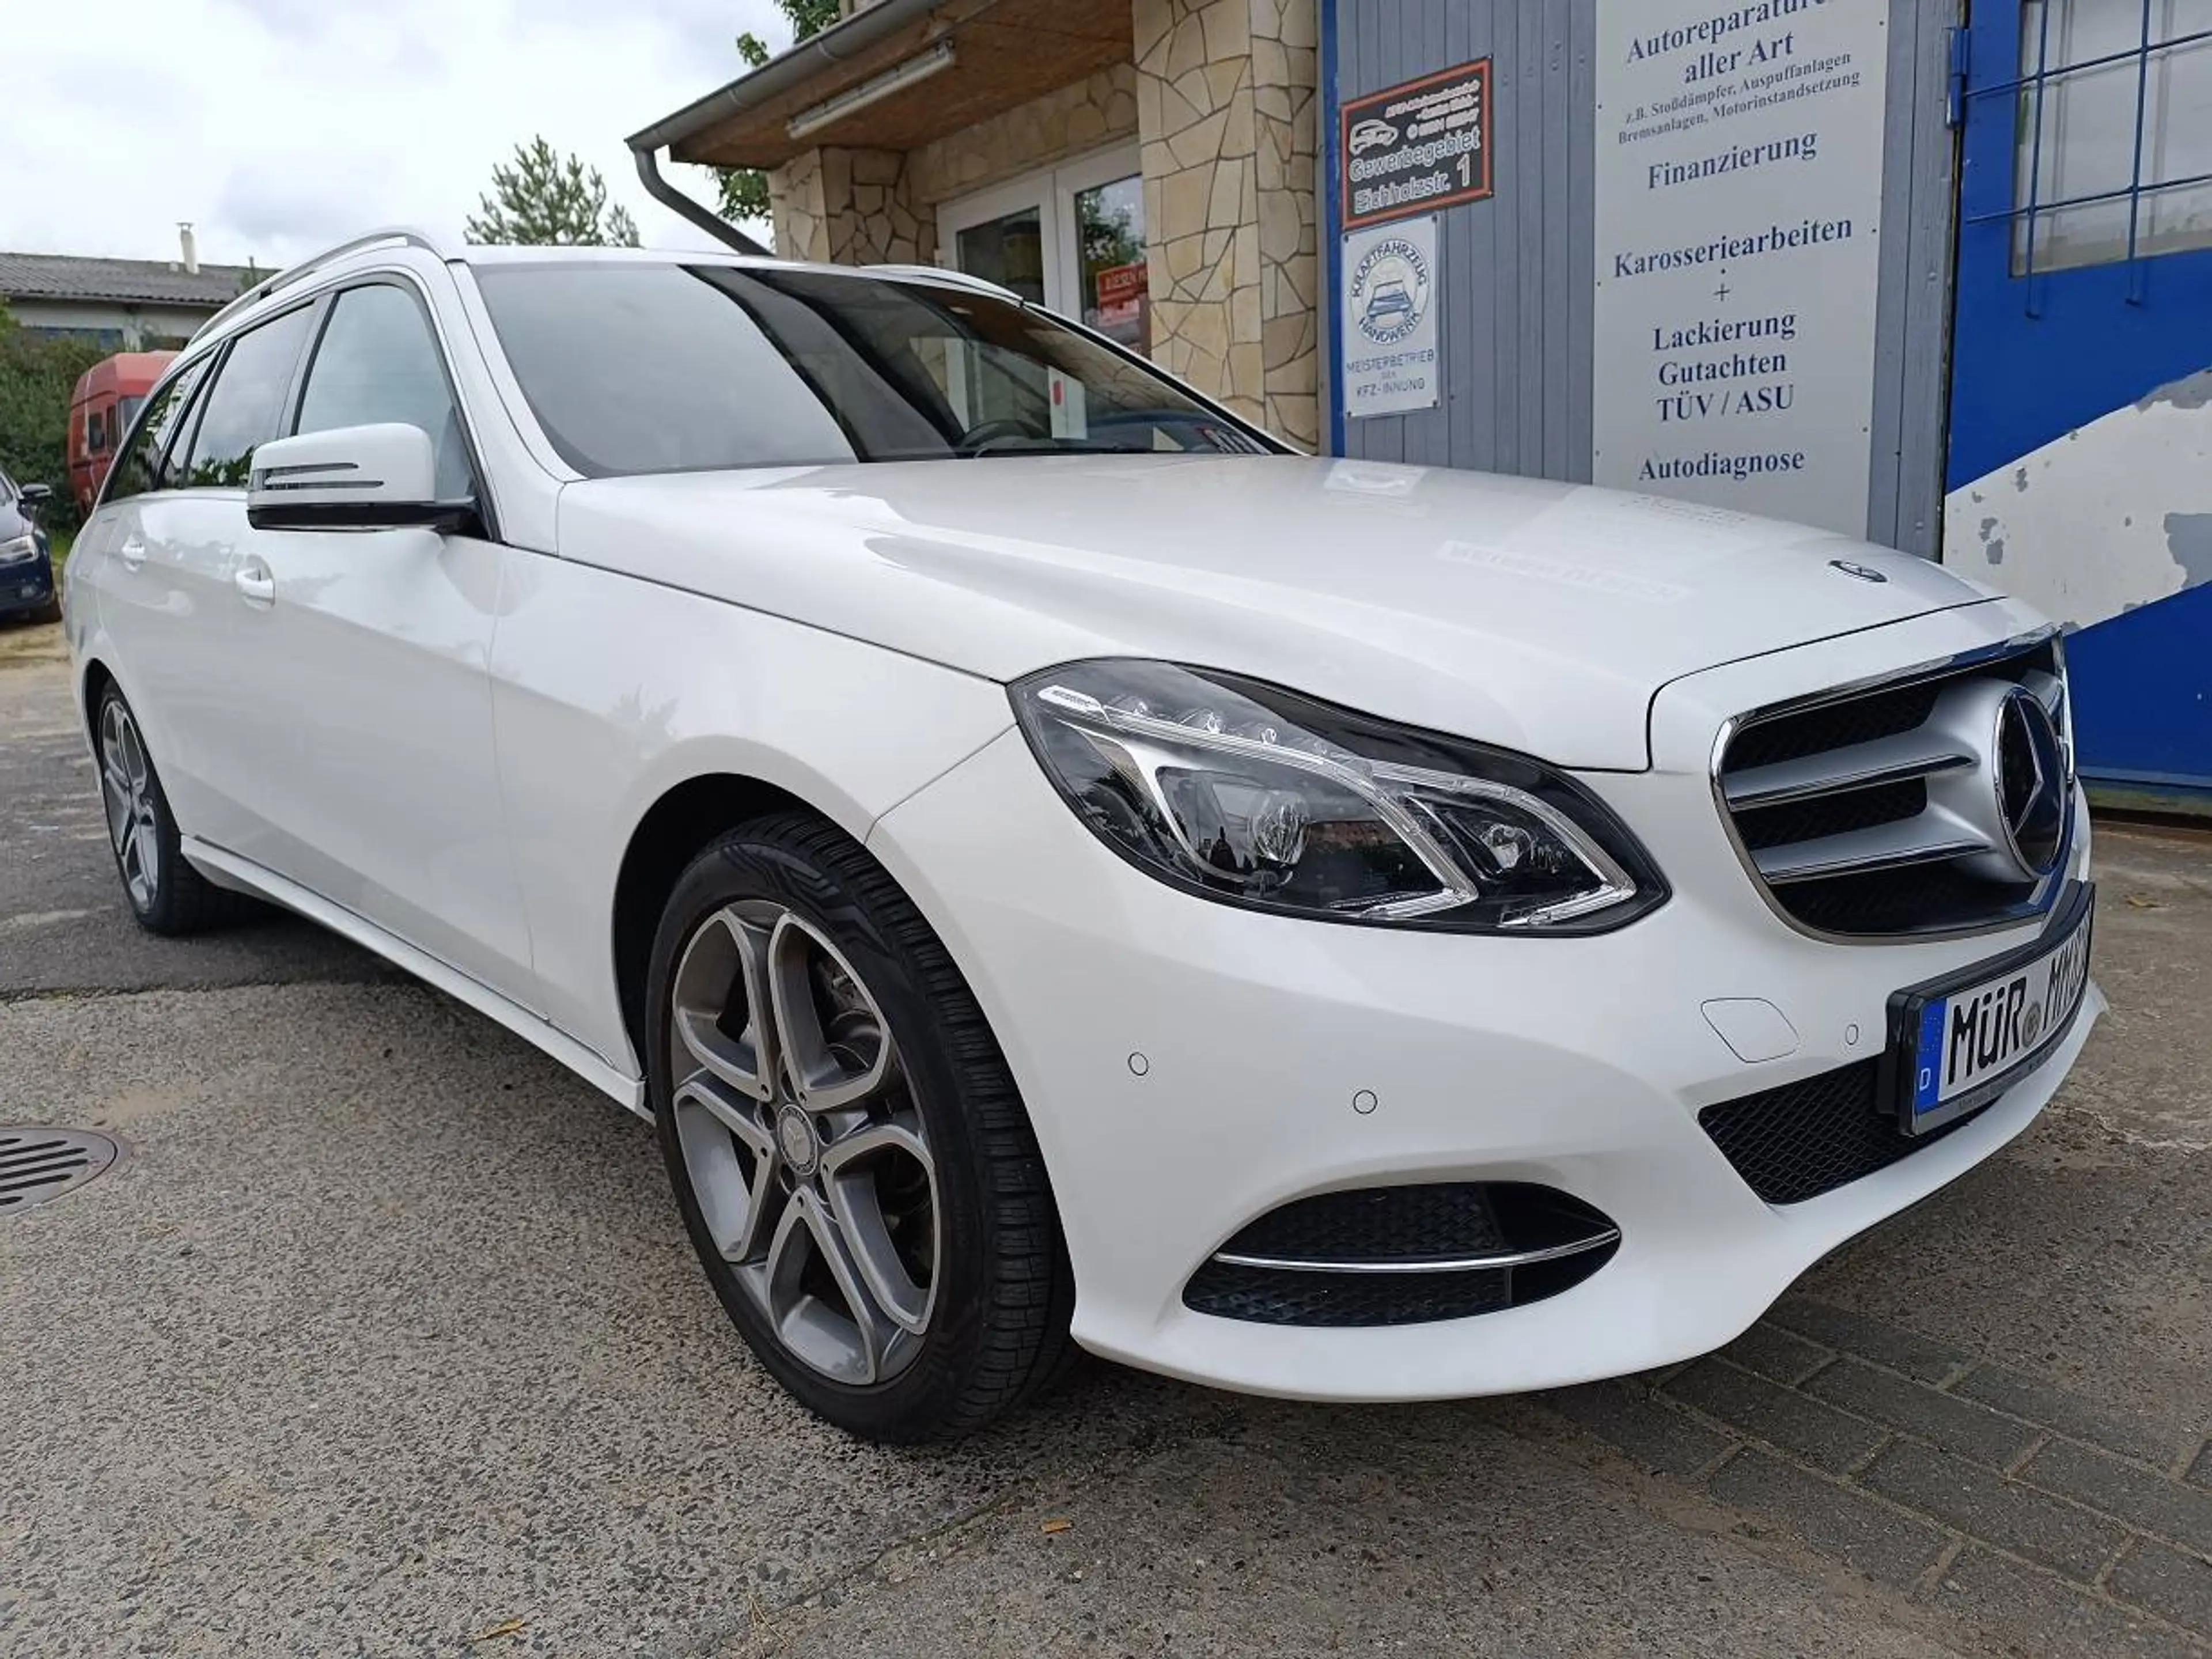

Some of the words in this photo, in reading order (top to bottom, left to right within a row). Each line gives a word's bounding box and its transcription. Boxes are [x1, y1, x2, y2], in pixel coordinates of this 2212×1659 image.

[1627, 0, 1826, 63] Autoreparatu
[1685, 51, 1741, 84] aller
[1748, 31, 1794, 66] Art
[1619, 112, 1709, 144] Bremsanlagen,
[1713, 71, 1861, 118] Motorinstandsetzung
[1625, 107, 1647, 124] z.B.
[1652, 85, 1736, 117] Stoßdämpfer,
[1742, 54, 1851, 92] Auspuffanlagen
[1456, 153, 1471, 187] 1
[1648, 132, 1817, 189] Finanzierung
[1615, 218, 1853, 278] Karosseriearbeiten
[1653, 313, 1796, 351] Lackierung
[1658, 353, 1786, 387] Gutachten
[1656, 389, 1715, 422] TÜV
[1735, 384, 1794, 414] ASU
[1639, 450, 1805, 481] Autodiagnose
[1948, 976, 2027, 1085] MÜR
[1919, 1067, 1931, 1092] D
